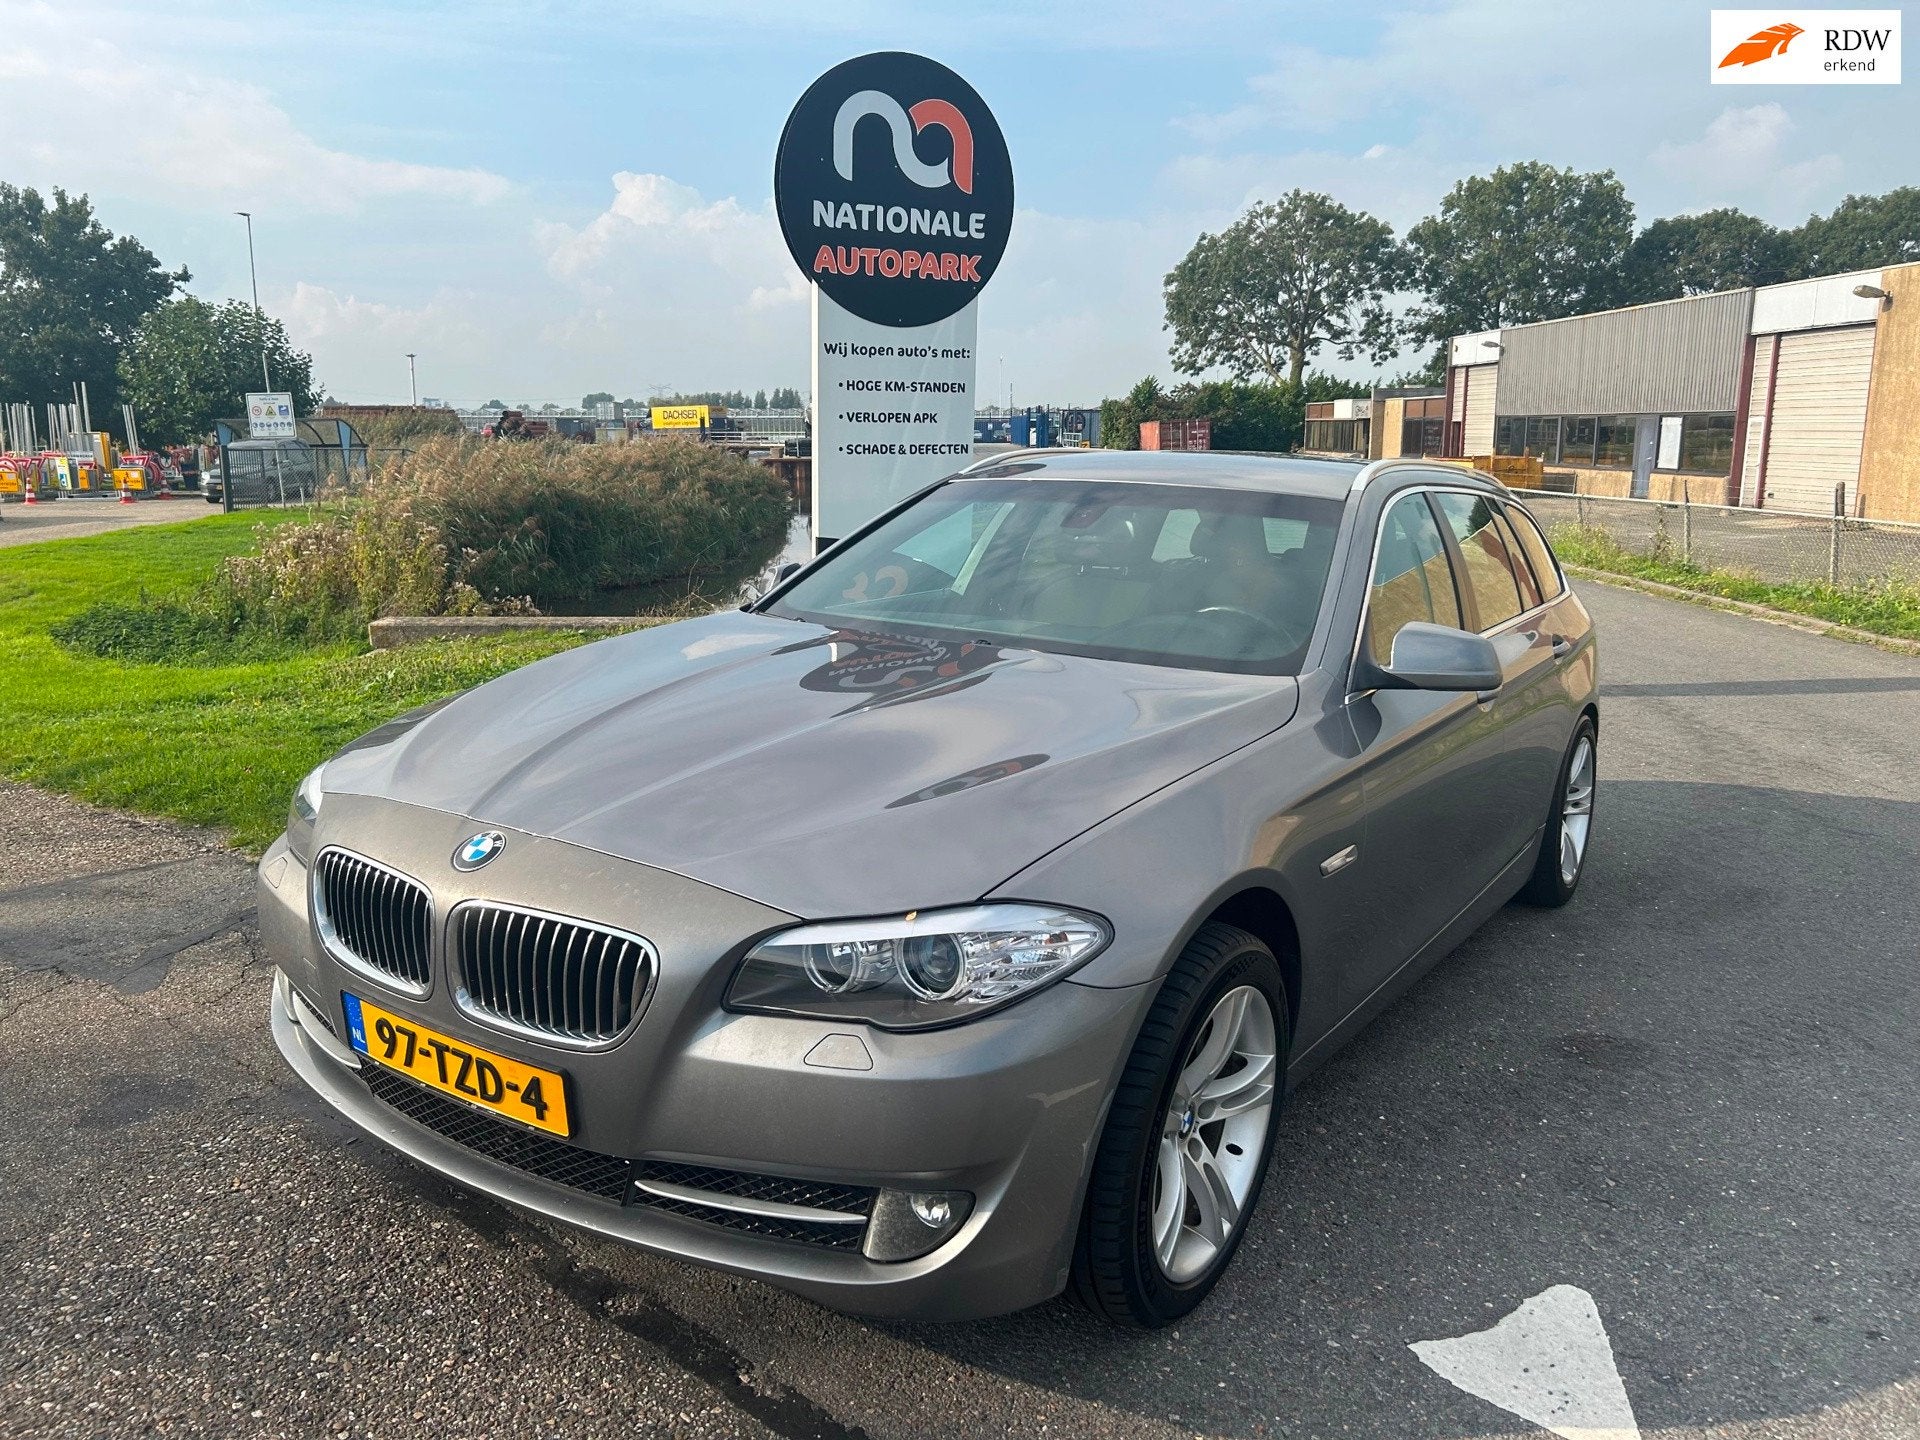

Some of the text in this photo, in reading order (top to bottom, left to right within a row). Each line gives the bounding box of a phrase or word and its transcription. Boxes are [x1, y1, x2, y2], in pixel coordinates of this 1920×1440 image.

[812, 199, 986, 240] NATIONALE
[813, 244, 982, 283] AUTOPARK
[823, 342, 971, 359] Wij kopen auto's met:
[846, 380, 966, 394] HOGE KM-STANDEN
[662, 410, 698, 420] DACHSER
[846, 411, 938, 424] VERLOPEN APK
[846, 443, 969, 455] SCHADE & DEFECTEN
[352, 1026, 366, 1044] NL
[375, 1017, 548, 1122] 97-TZD-4
